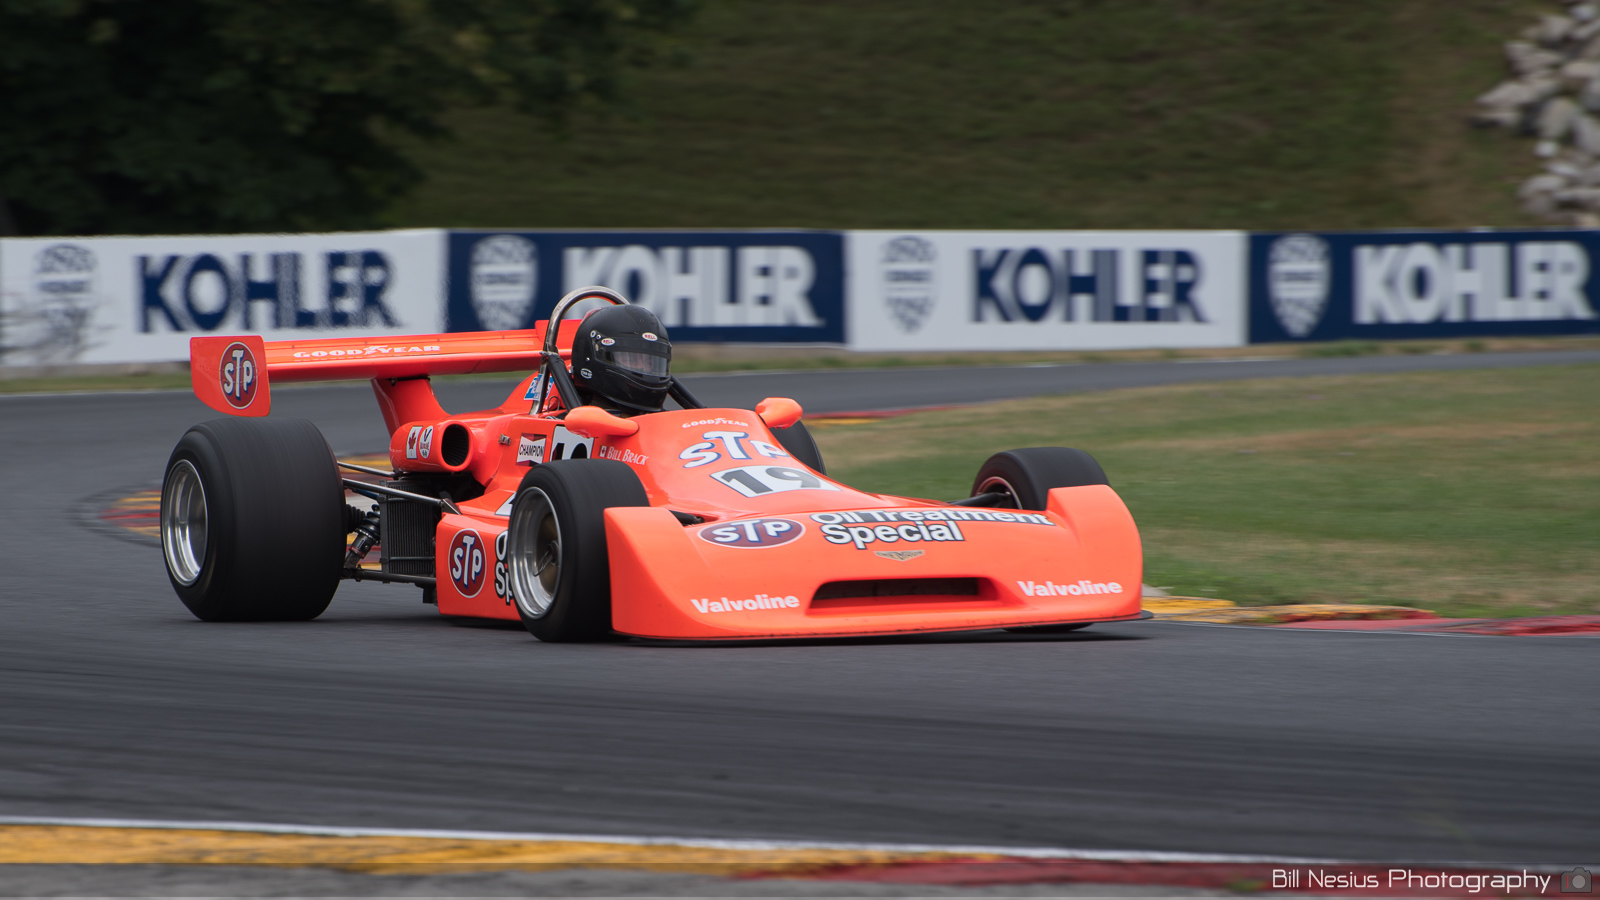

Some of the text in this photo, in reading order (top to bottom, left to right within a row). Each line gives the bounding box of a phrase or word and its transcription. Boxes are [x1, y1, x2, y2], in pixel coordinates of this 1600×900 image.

[135, 250, 400, 332] KOHLER
[565, 246, 823, 327] KOHLER
[971, 248, 1210, 322] KOHLER
[1352, 241, 1597, 324] KOHLER
[293, 345, 441, 358] GOODYEAR
[223, 349, 254, 400] STP
[682, 418, 748, 428] GOODYEAR
[519, 443, 545, 457] CHAMPION
[679, 431, 790, 468] STP
[721, 467, 821, 494] 19
[711, 519, 793, 543] STP
[810, 510, 1056, 526] Oil Treatment
[821, 521, 965, 550] Special
[452, 535, 483, 589] STP
[1017, 580, 1123, 598] Valvoline
[690, 594, 800, 613] Valvoline
